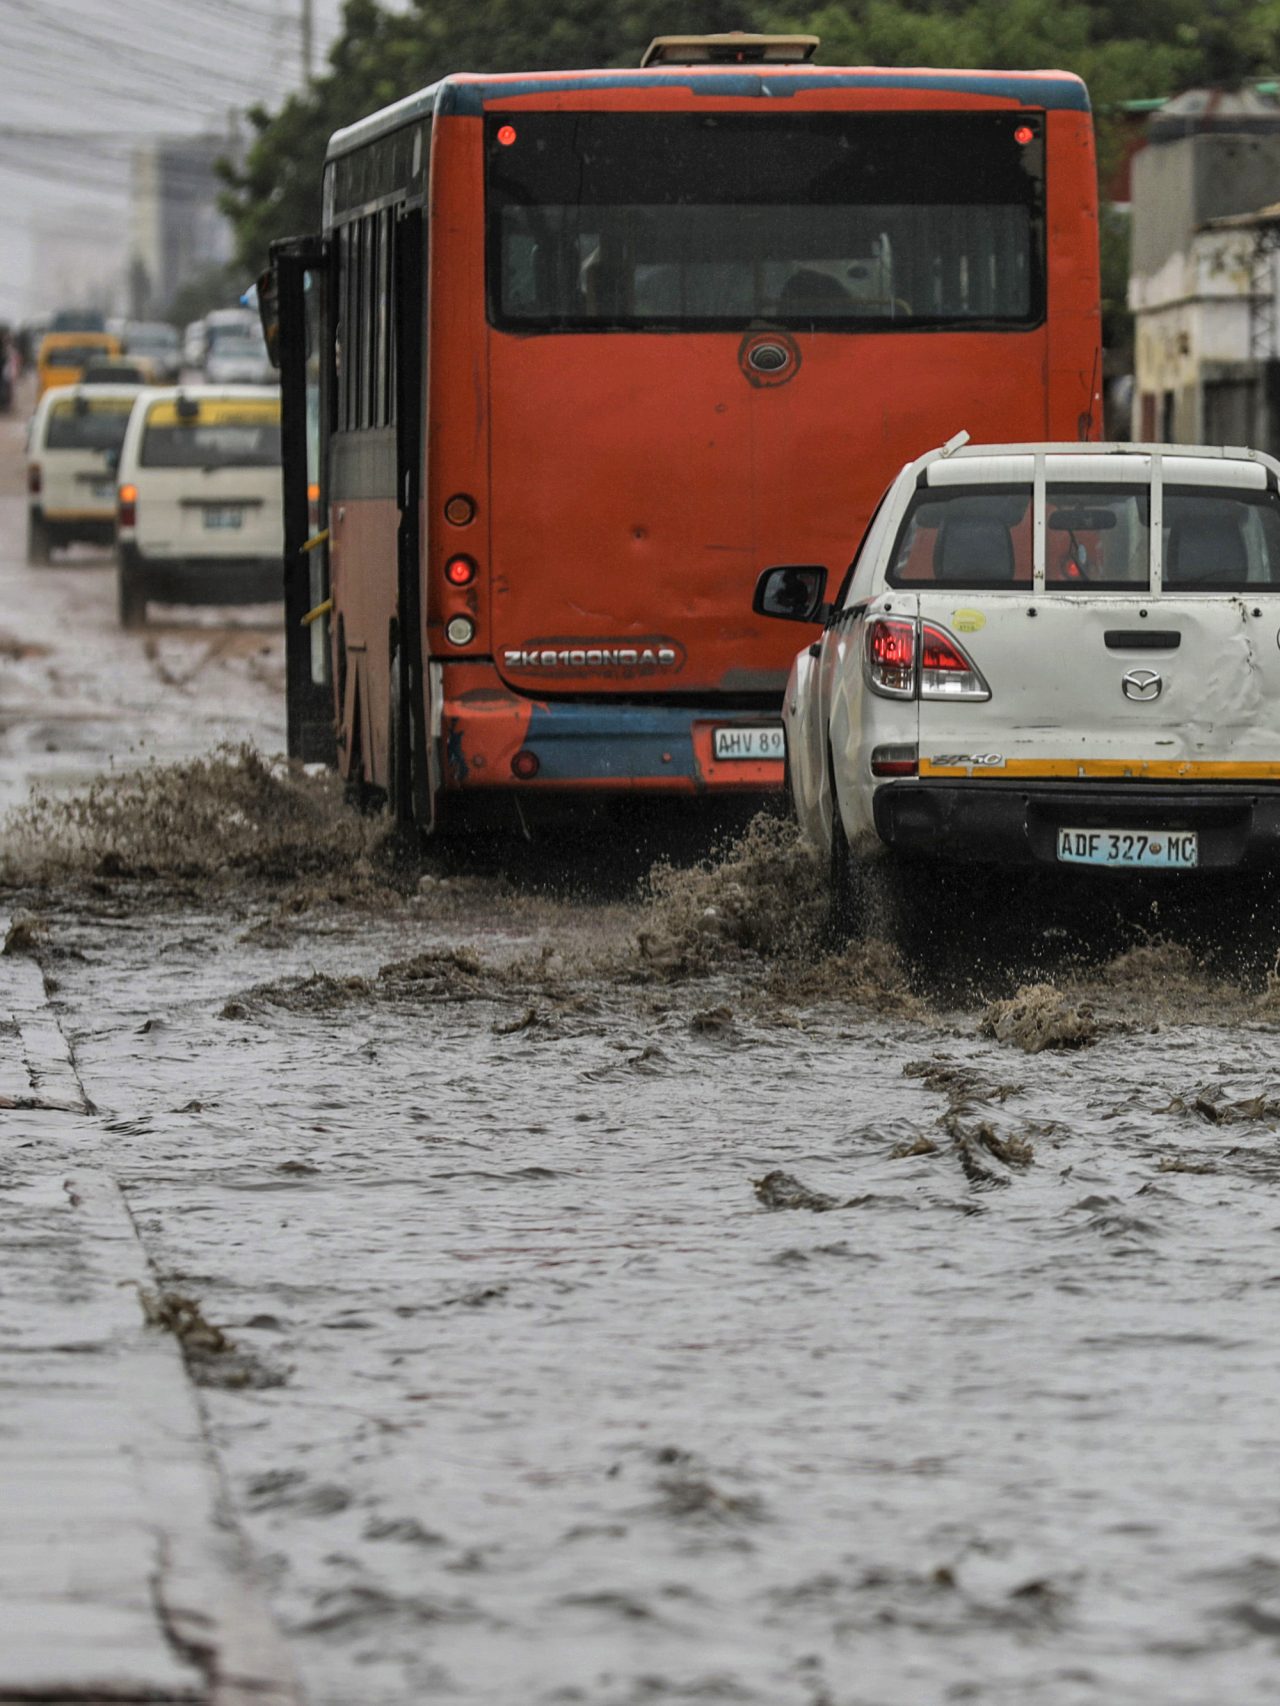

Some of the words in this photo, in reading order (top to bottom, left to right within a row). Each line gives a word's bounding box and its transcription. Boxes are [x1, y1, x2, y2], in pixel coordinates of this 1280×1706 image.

[719, 733, 752, 753] AHV
[1061, 833, 1101, 858] ADF
[1107, 835, 1149, 861] 327
[1167, 836, 1194, 862] MC
